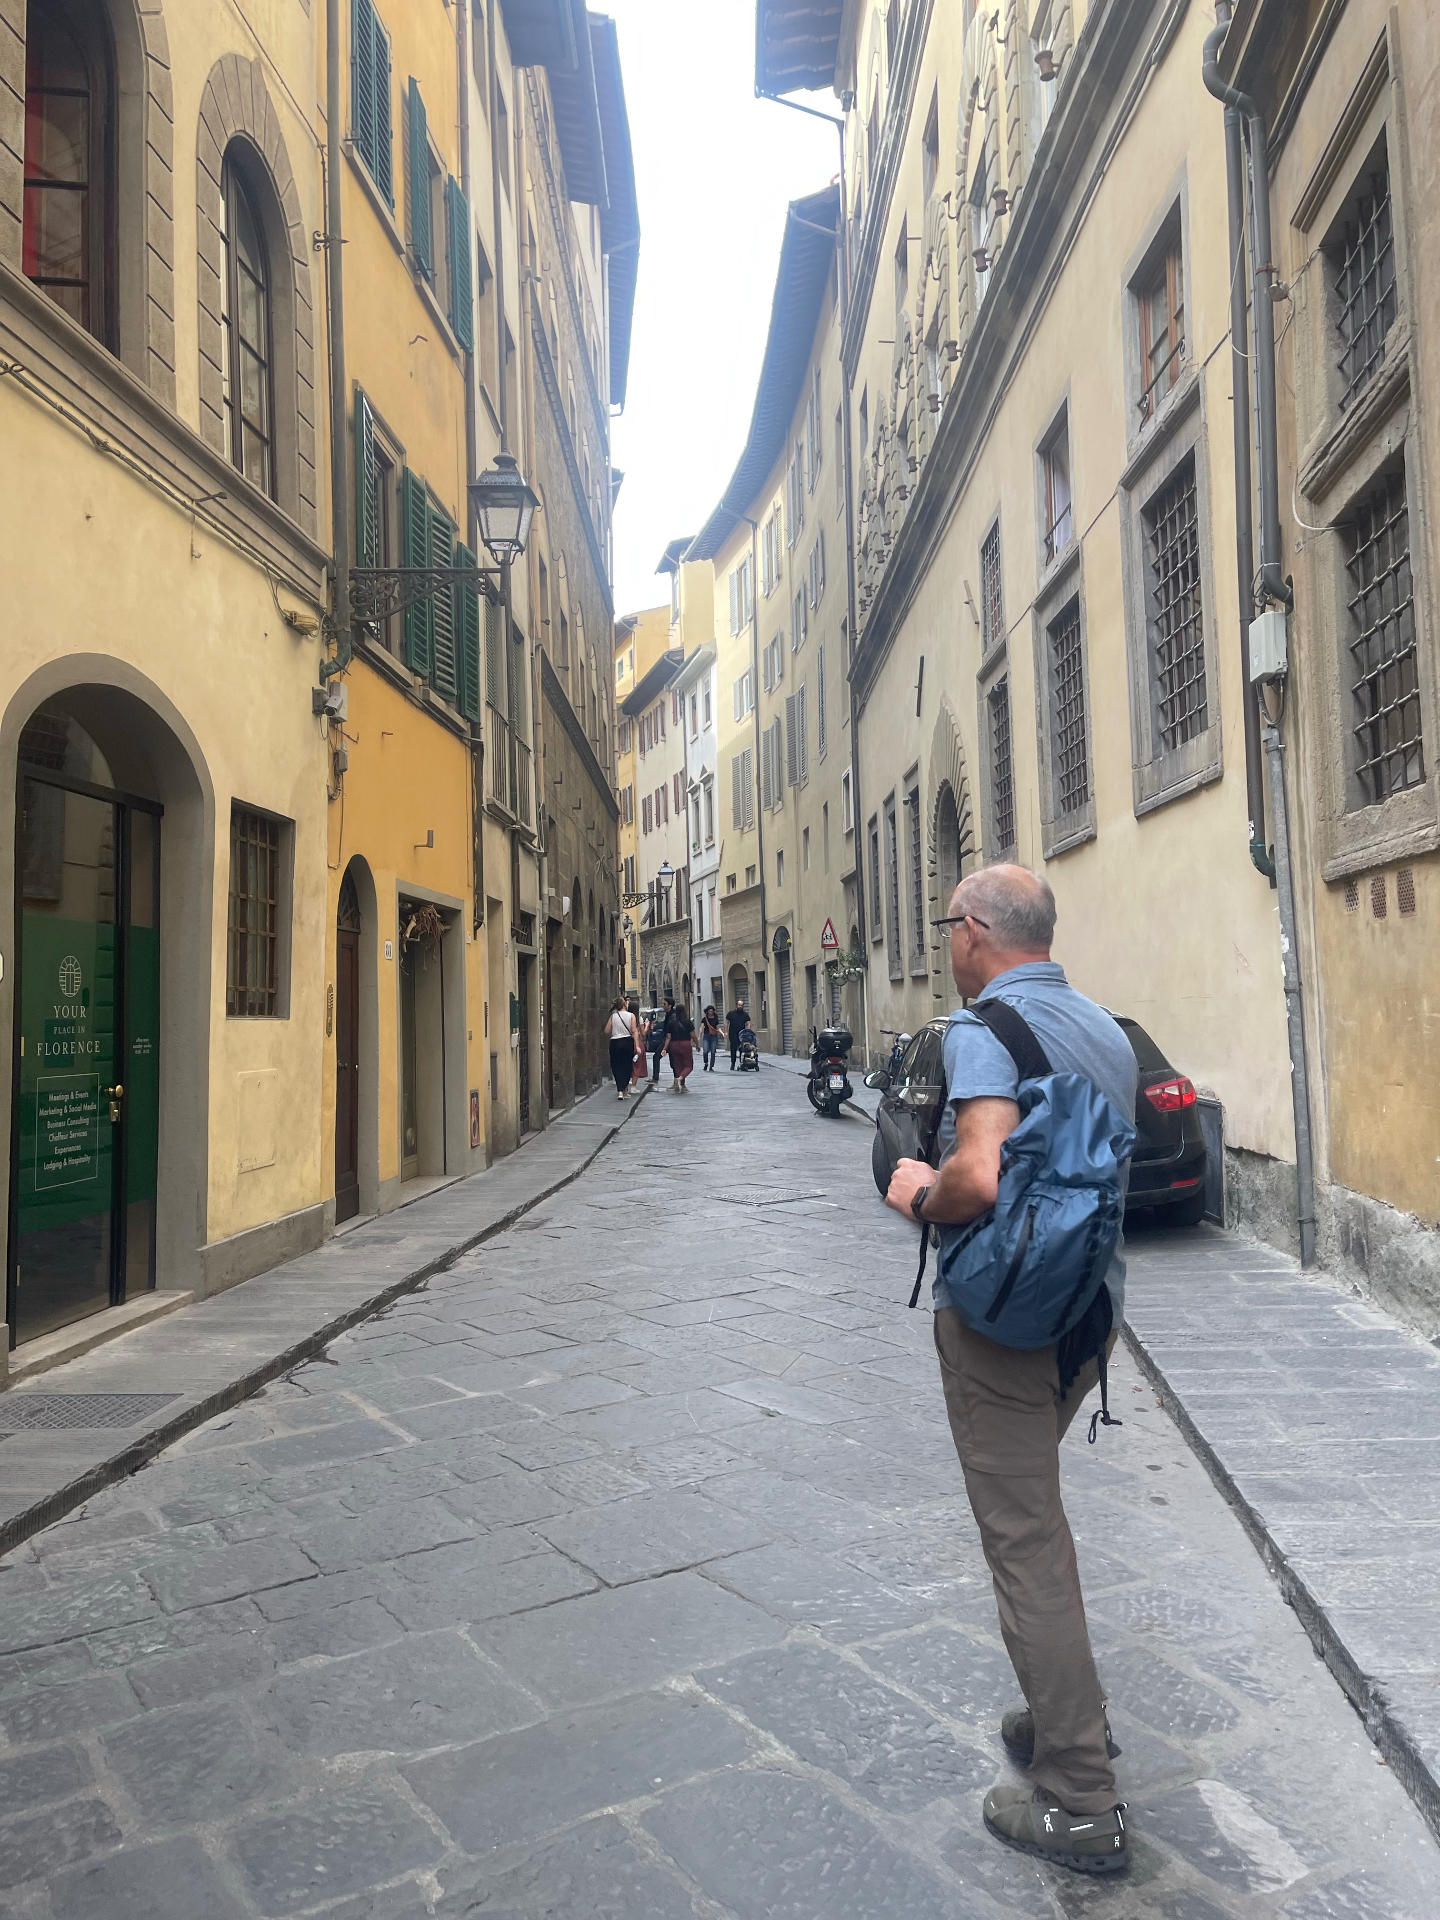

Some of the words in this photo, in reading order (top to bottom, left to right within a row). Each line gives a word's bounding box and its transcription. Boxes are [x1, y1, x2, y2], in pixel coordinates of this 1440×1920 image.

[53, 1005, 87, 1018] YOUR
[53, 1026, 75, 1034] PLACE
[77, 1025, 86, 1033] IN
[37, 1040, 100, 1056] FLORENCE
[49, 1092, 70, 1102] Meetings
[75, 1090, 89, 1099] Events
[39, 1106, 63, 1117] Marketing
[63, 1104, 68, 1113] &
[68, 1103, 83, 1112] Social
[83, 1102, 97, 1111] Media
[47, 1120, 66, 1129] Business
[66, 1116, 90, 1126] Consulting
[69, 1130, 88, 1139] Services
[54, 1144, 82, 1156] Experiences
[43, 1160, 63, 1171] Lodging
